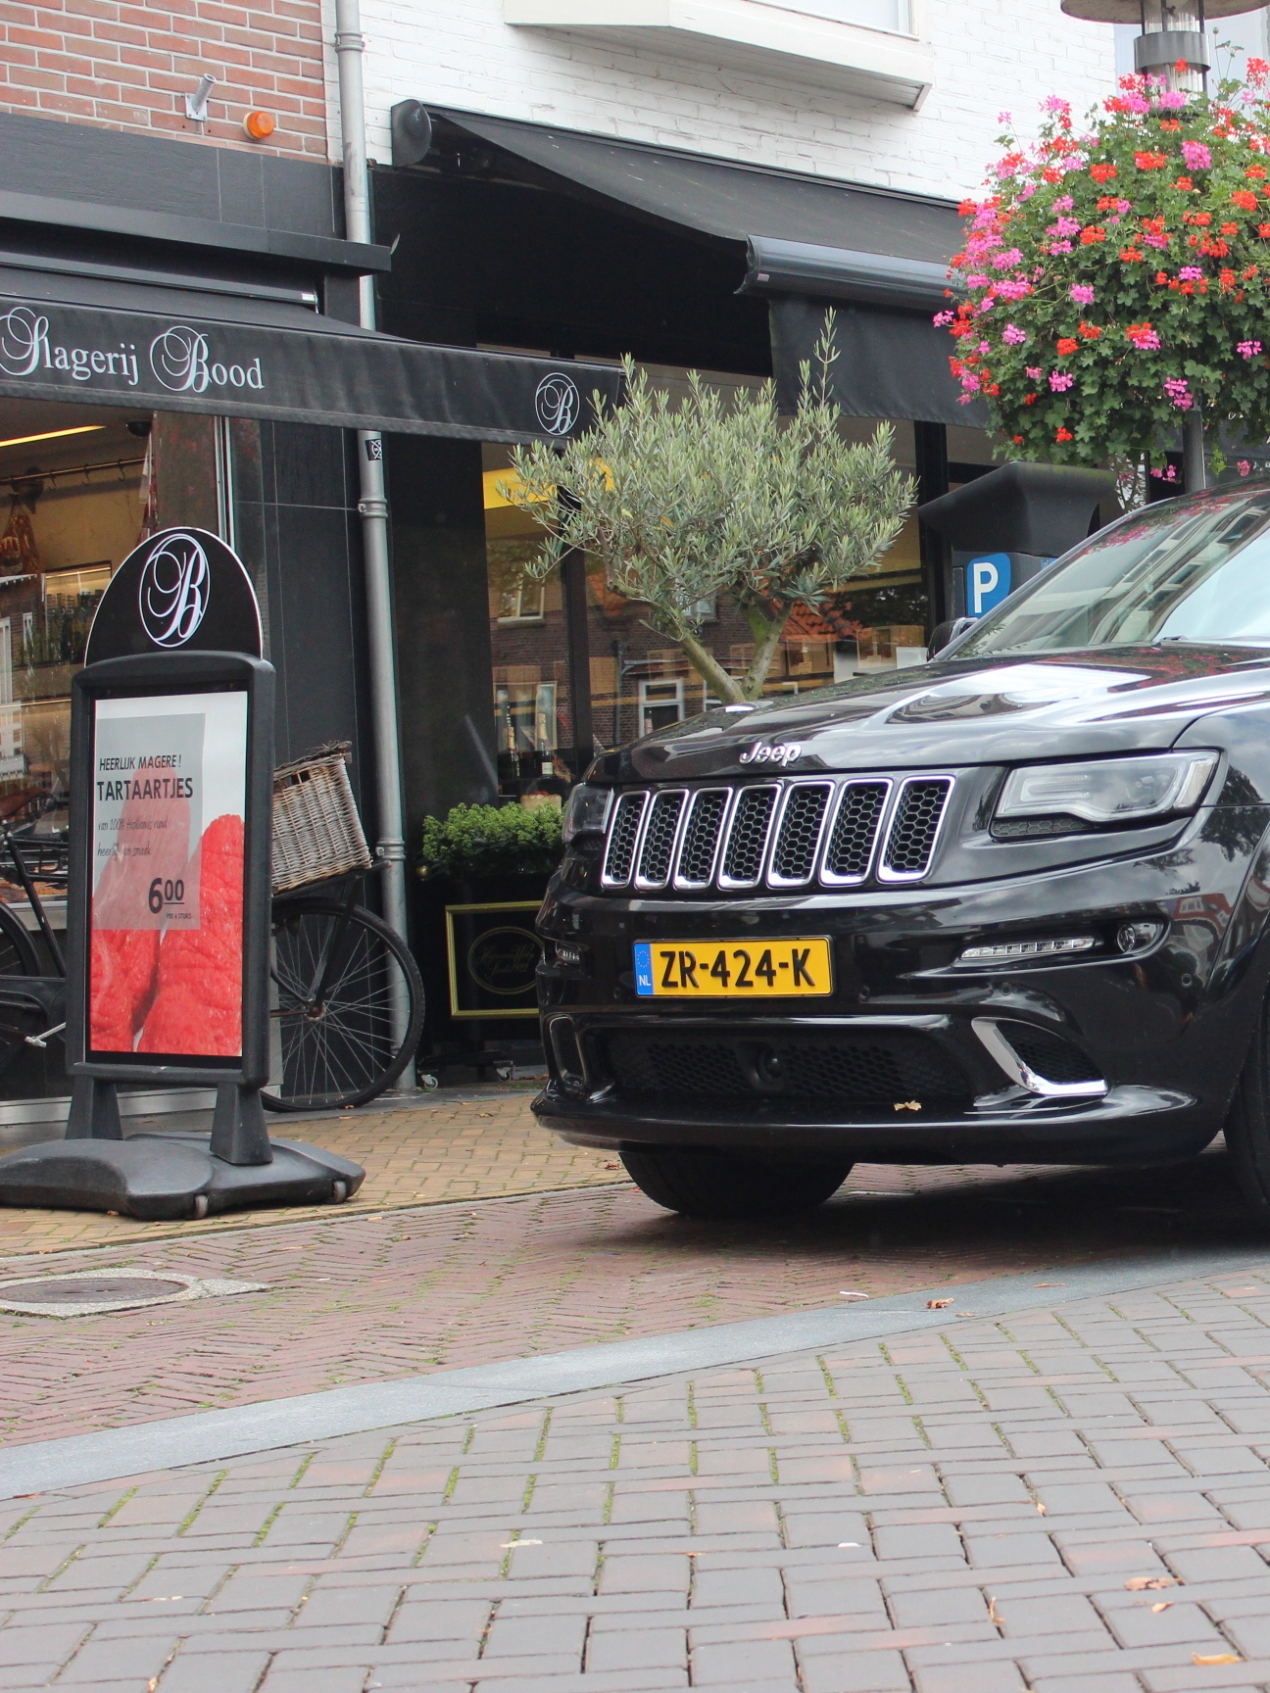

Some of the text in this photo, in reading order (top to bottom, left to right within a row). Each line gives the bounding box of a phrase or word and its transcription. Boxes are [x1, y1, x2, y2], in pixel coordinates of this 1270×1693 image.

[0, 306, 265, 393] Slagerij Bood
[973, 562, 999, 614] P
[99, 756, 136, 771] HEERLIJK
[739, 741, 802, 767] Jeep
[97, 777, 193, 801] TARTAARTJES
[639, 947, 816, 989] NL ZR-424-K
